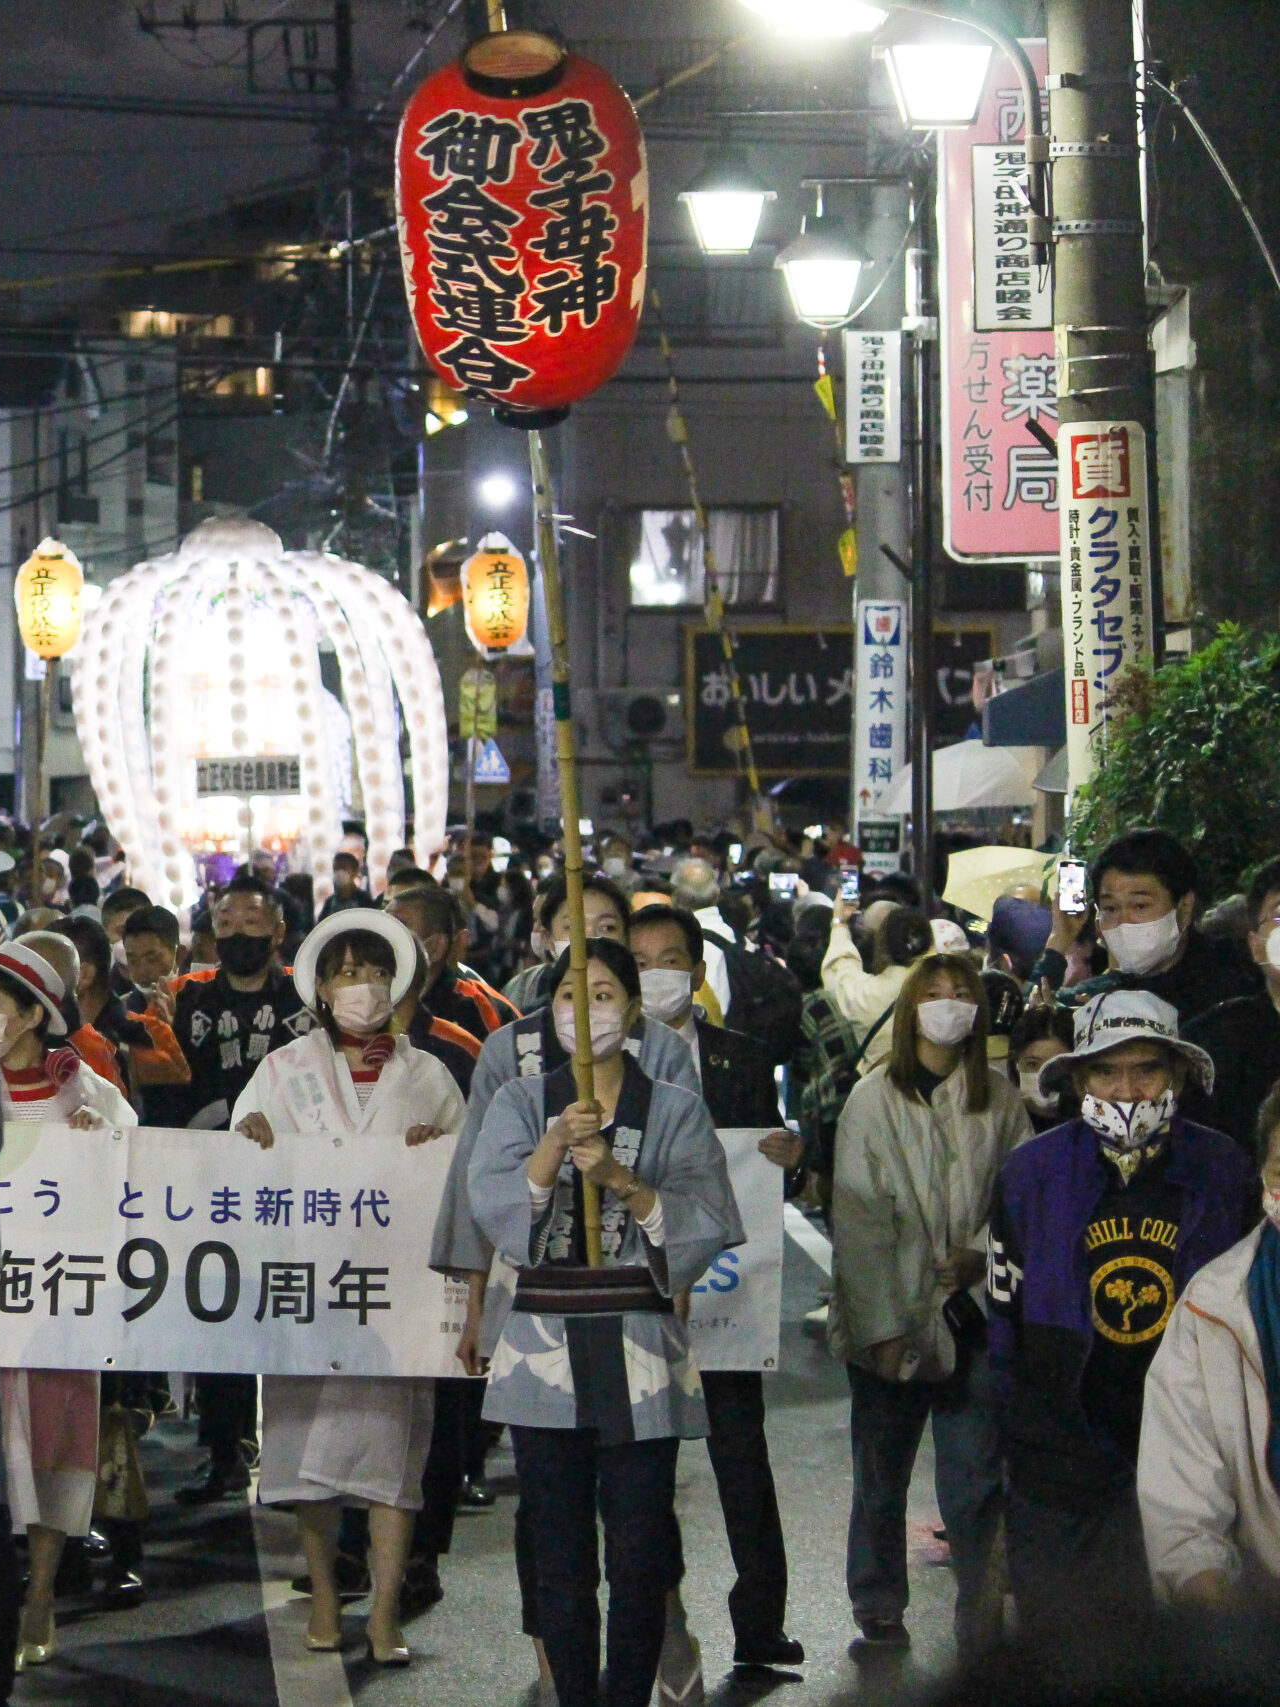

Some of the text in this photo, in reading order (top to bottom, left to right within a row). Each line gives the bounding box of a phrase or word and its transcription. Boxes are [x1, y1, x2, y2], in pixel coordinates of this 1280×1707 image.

[416, 109, 536, 404] 御会式連合
[523, 100, 619, 336] 鬼子母神
[993, 152, 1032, 320] 鬼子母神通り商店睦会
[1075, 439, 1125, 495] 質
[868, 652, 895, 783] 鈴木歯科
[117, 1181, 392, 1228] としま新時代
[1085, 1217, 1179, 1250] HILL COU
